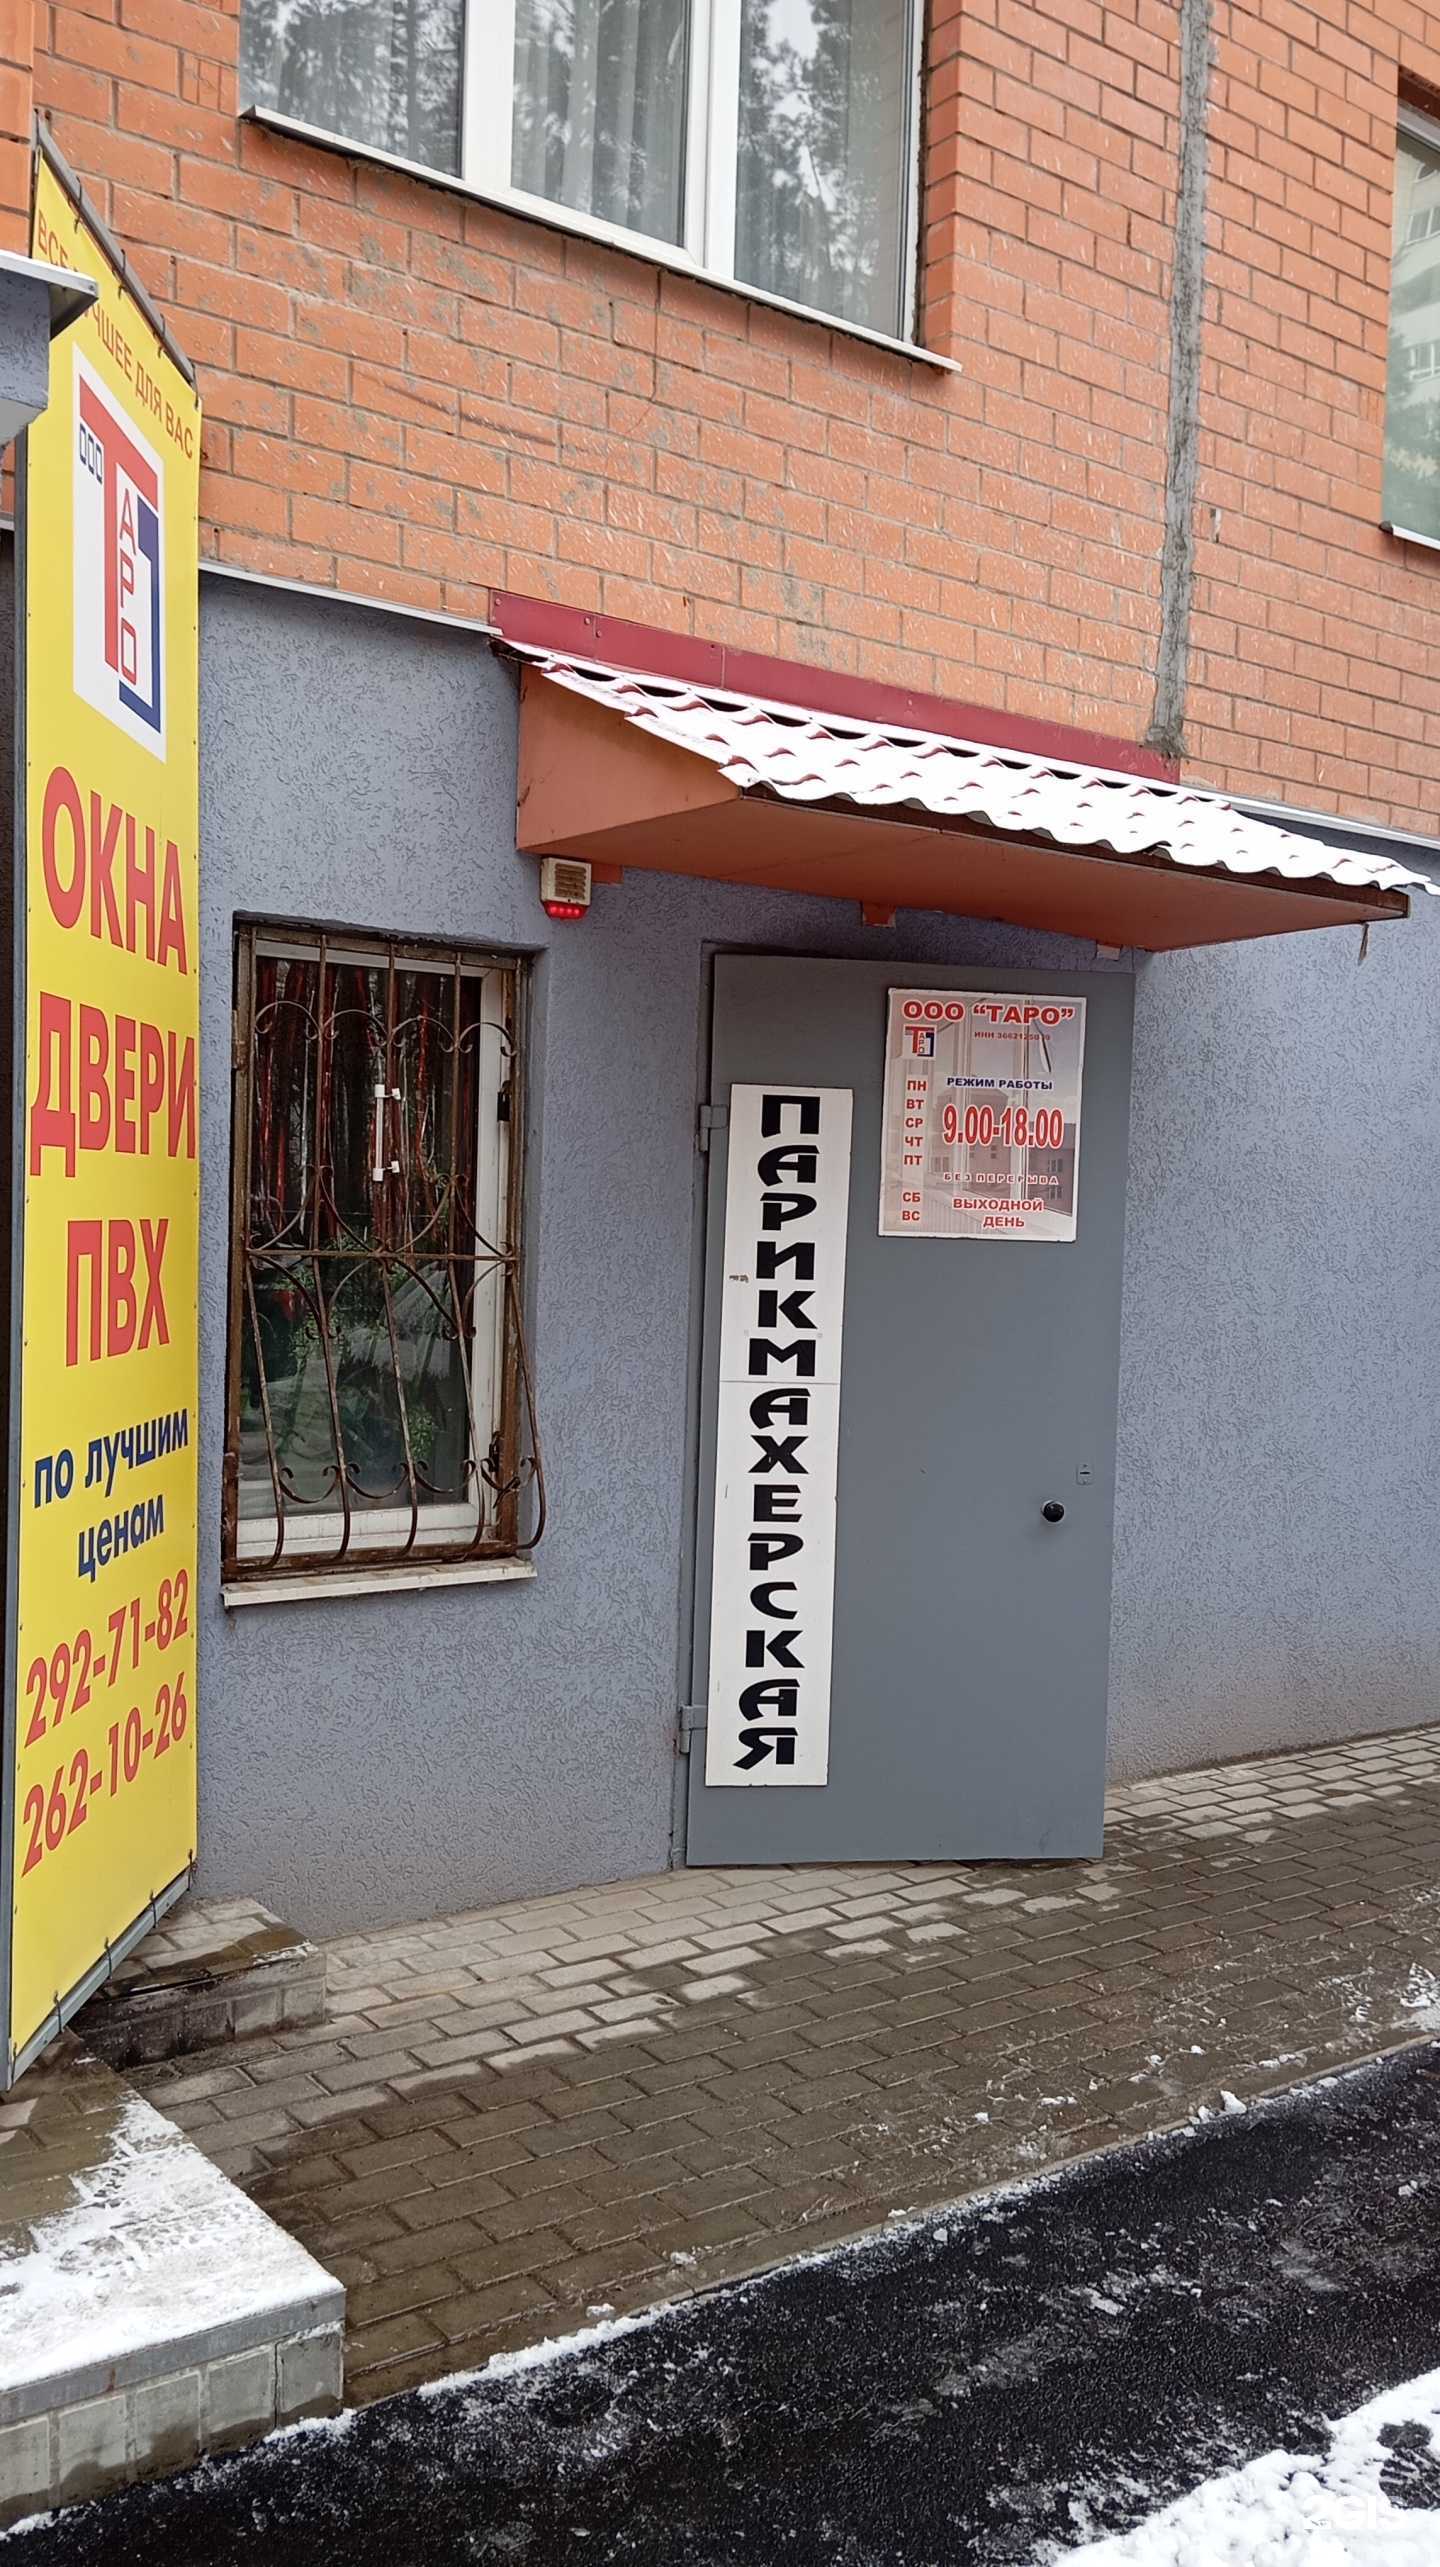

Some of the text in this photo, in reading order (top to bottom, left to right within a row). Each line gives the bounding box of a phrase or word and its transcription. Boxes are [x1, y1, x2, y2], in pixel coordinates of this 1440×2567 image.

[136, 361, 162, 421] ДЛЯ
[166, 402, 193, 459] ВАС
[79, 423, 103, 484] ООО
[42, 766, 188, 976] ОКНА
[903, 1001, 964, 1020] ООО
[974, 1031, 995, 1040] ИНН
[30, 991, 196, 1178] ДВЕРИ
[907, 1080, 926, 1091] ПН
[947, 1077, 1053, 1090] РЕЖИМ РАБОТЫ
[906, 1099, 924, 1110] ВТ
[905, 1117, 923, 1128] СР
[943, 1105, 1063, 1148] 9.00-18.00
[905, 1136, 923, 1147] ЧТ
[903, 1155, 922, 1166] ПТ
[944, 1172, 1059, 1185] БЕЗ ПЕРЕРЫВА
[902, 1191, 921, 1203] СБ
[953, 1198, 1043, 1212] ВЫХОДНОЙ
[902, 1210, 920, 1221] ВС
[983, 1216, 1025, 1228] ДЕНЬ
[66, 1218, 169, 1368] ПВХ
[732, 1093, 821, 1769] ПАРИКМАХЕРСКАЯ
[34, 1408, 189, 1508] по лучшим
[78, 1493, 165, 1582] ценам
[24, 1568, 190, 1750] 292-71-82
[21, 1671, 188, 1878] 262-10-26
